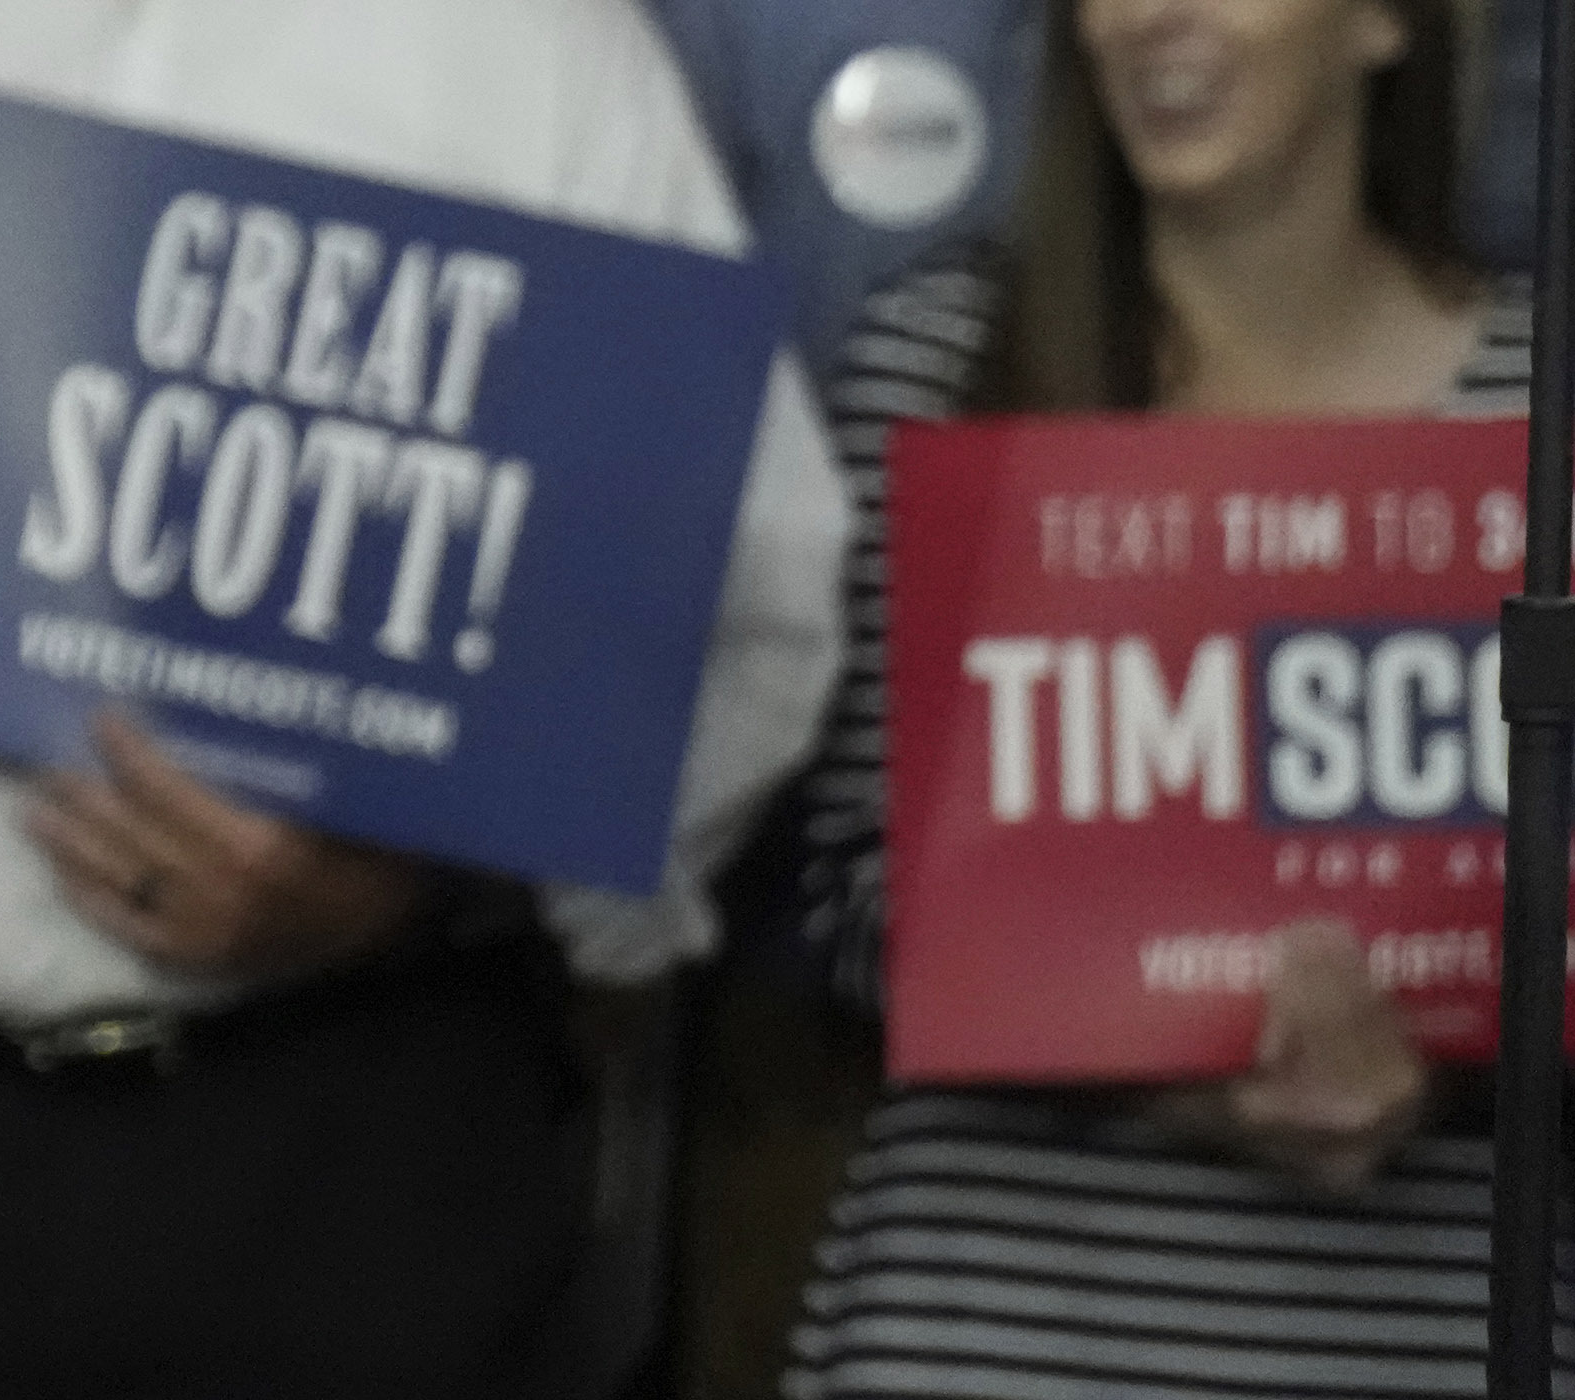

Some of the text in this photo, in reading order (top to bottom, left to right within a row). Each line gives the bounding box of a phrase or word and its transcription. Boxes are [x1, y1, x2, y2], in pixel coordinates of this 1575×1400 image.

[134, 190, 525, 437] GREAT
[18, 361, 533, 673] SCOTT!
[1039, 494, 1192, 580] TEXT
[1218, 492, 1347, 576] TIM
[1370, 490, 1455, 574] TO
[962, 632, 1244, 825] TIM
